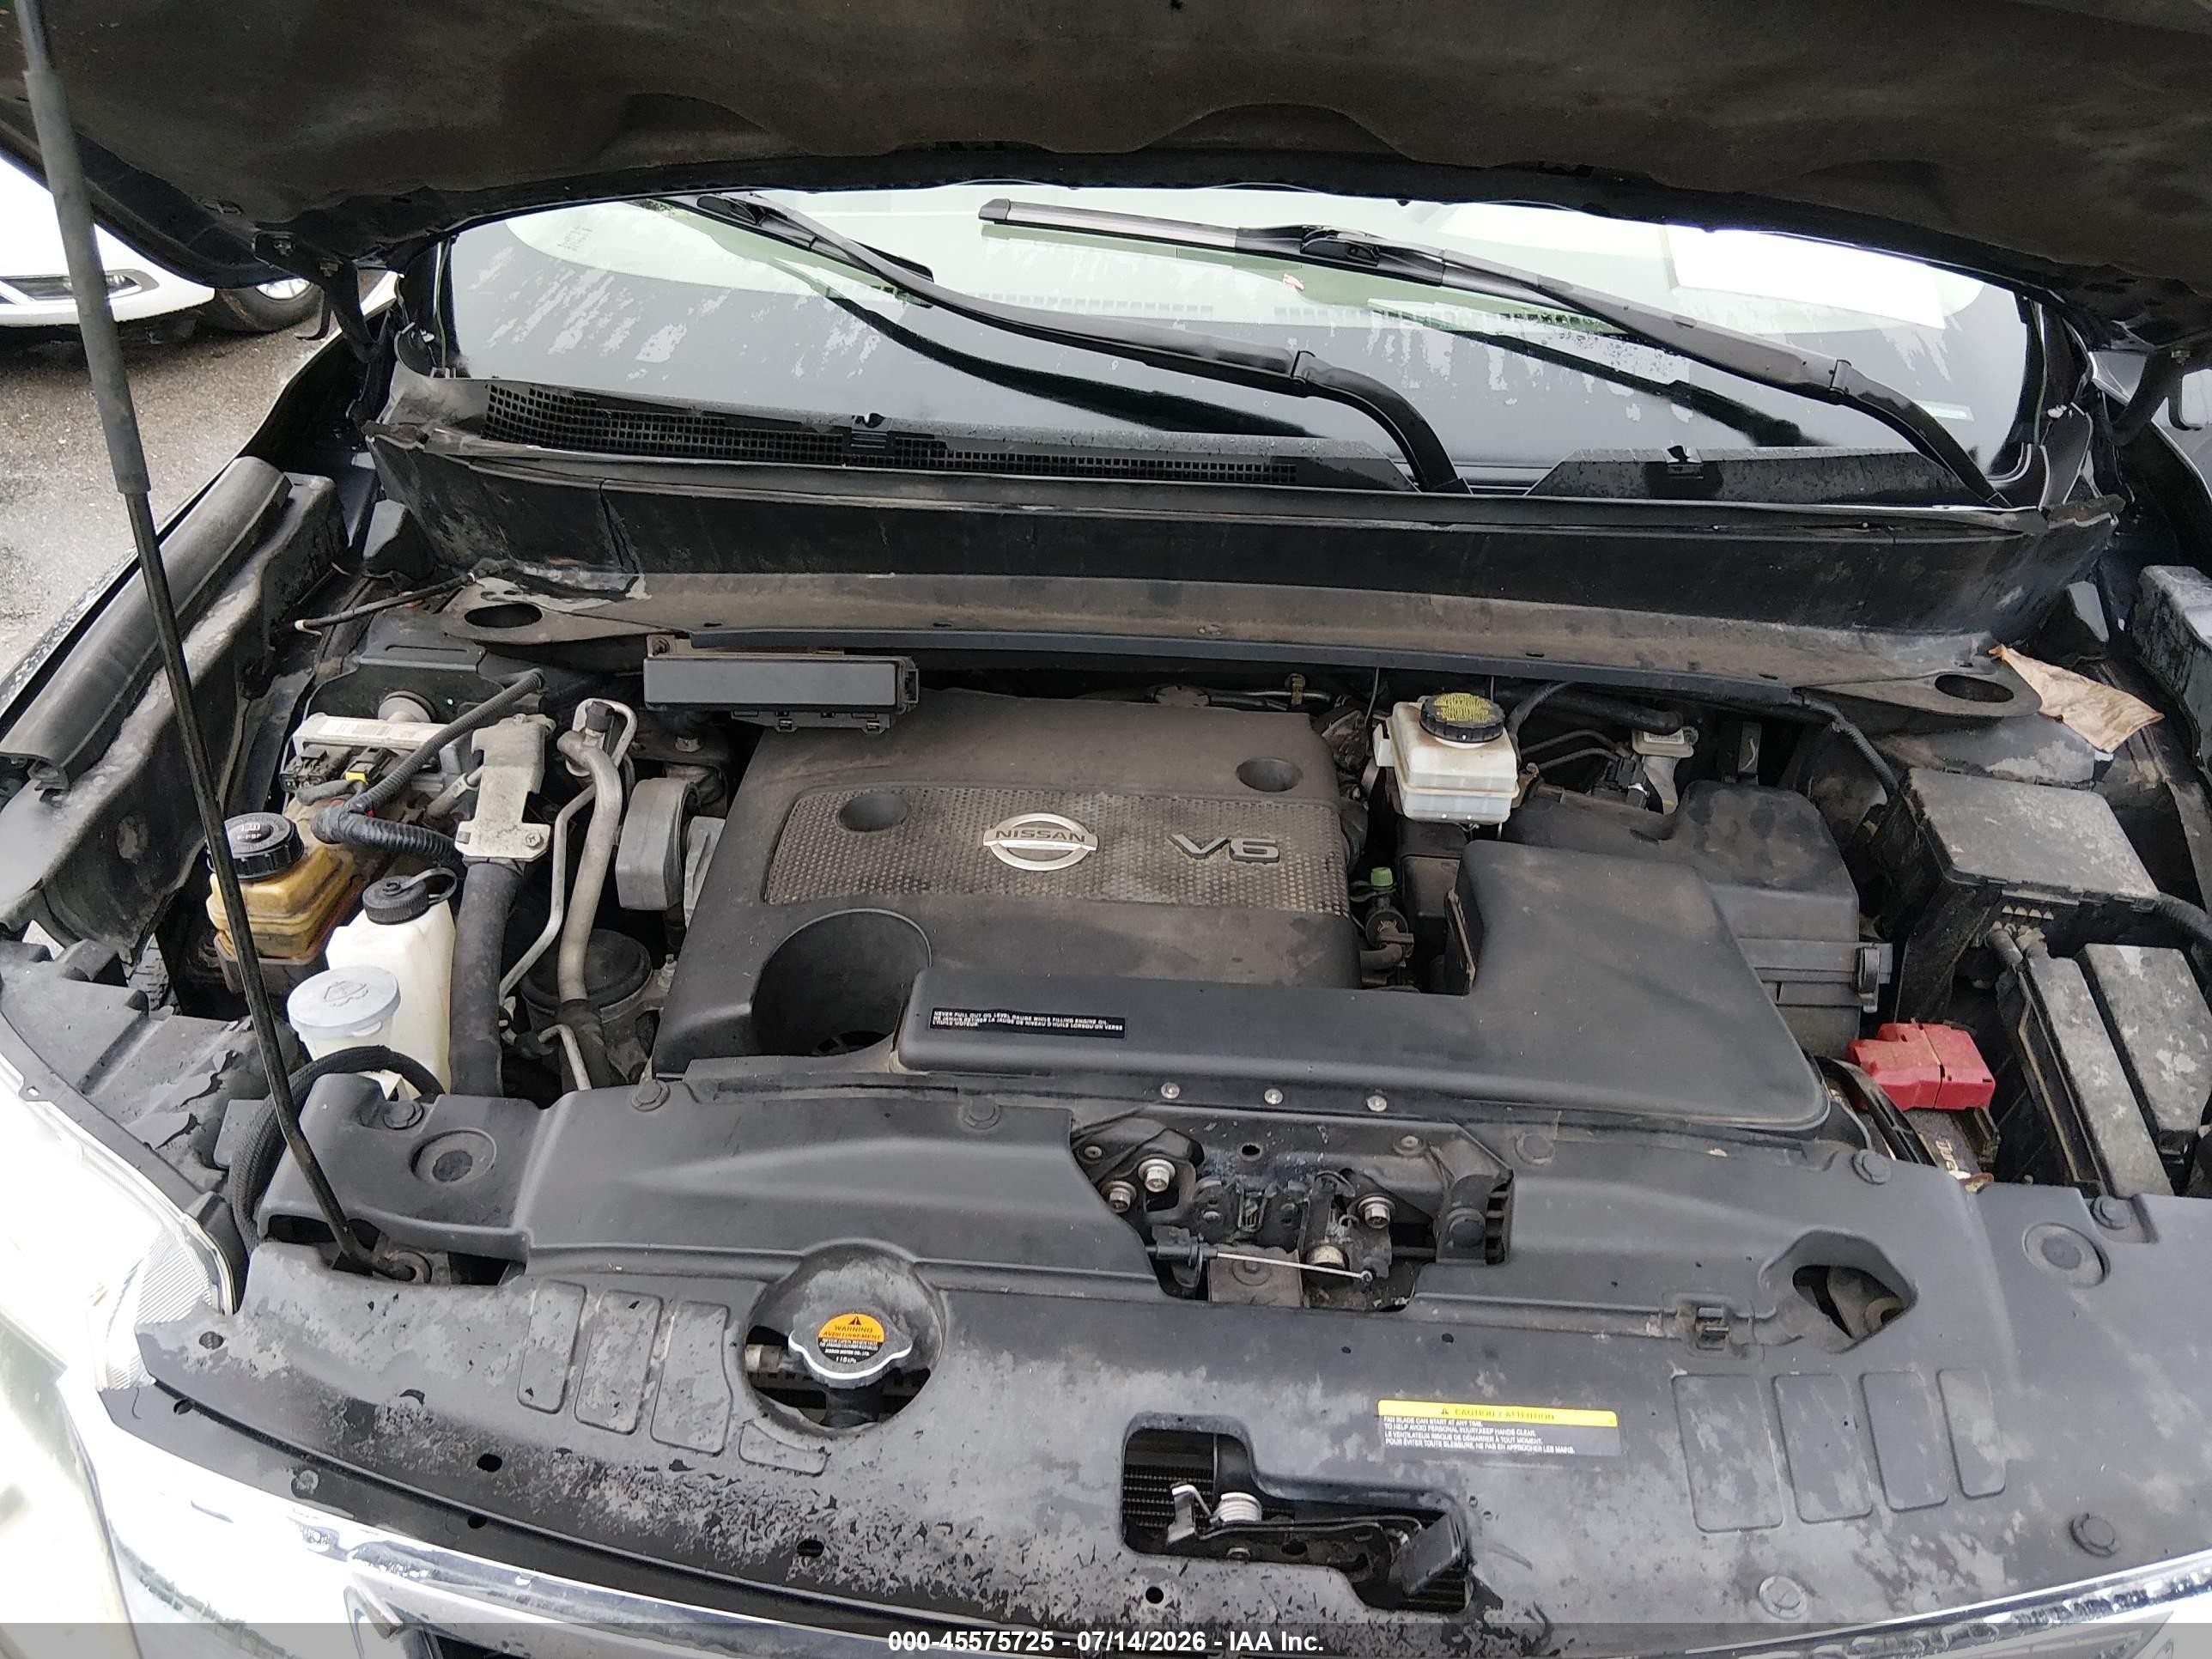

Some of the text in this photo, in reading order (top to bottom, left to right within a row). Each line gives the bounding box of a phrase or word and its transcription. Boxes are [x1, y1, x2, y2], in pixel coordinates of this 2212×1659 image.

[995, 830, 1085, 842] NISSAN
[1168, 834, 1279, 863] V6
[1455, 1408, 1495, 1418] CAUTION
[1505, 1411, 1554, 1421] ATTENTION
[1393, 1423, 1408, 1431] HELP
[1409, 1424, 1426, 1432] AVOID
[1427, 1425, 1459, 1434] PERSONAL
